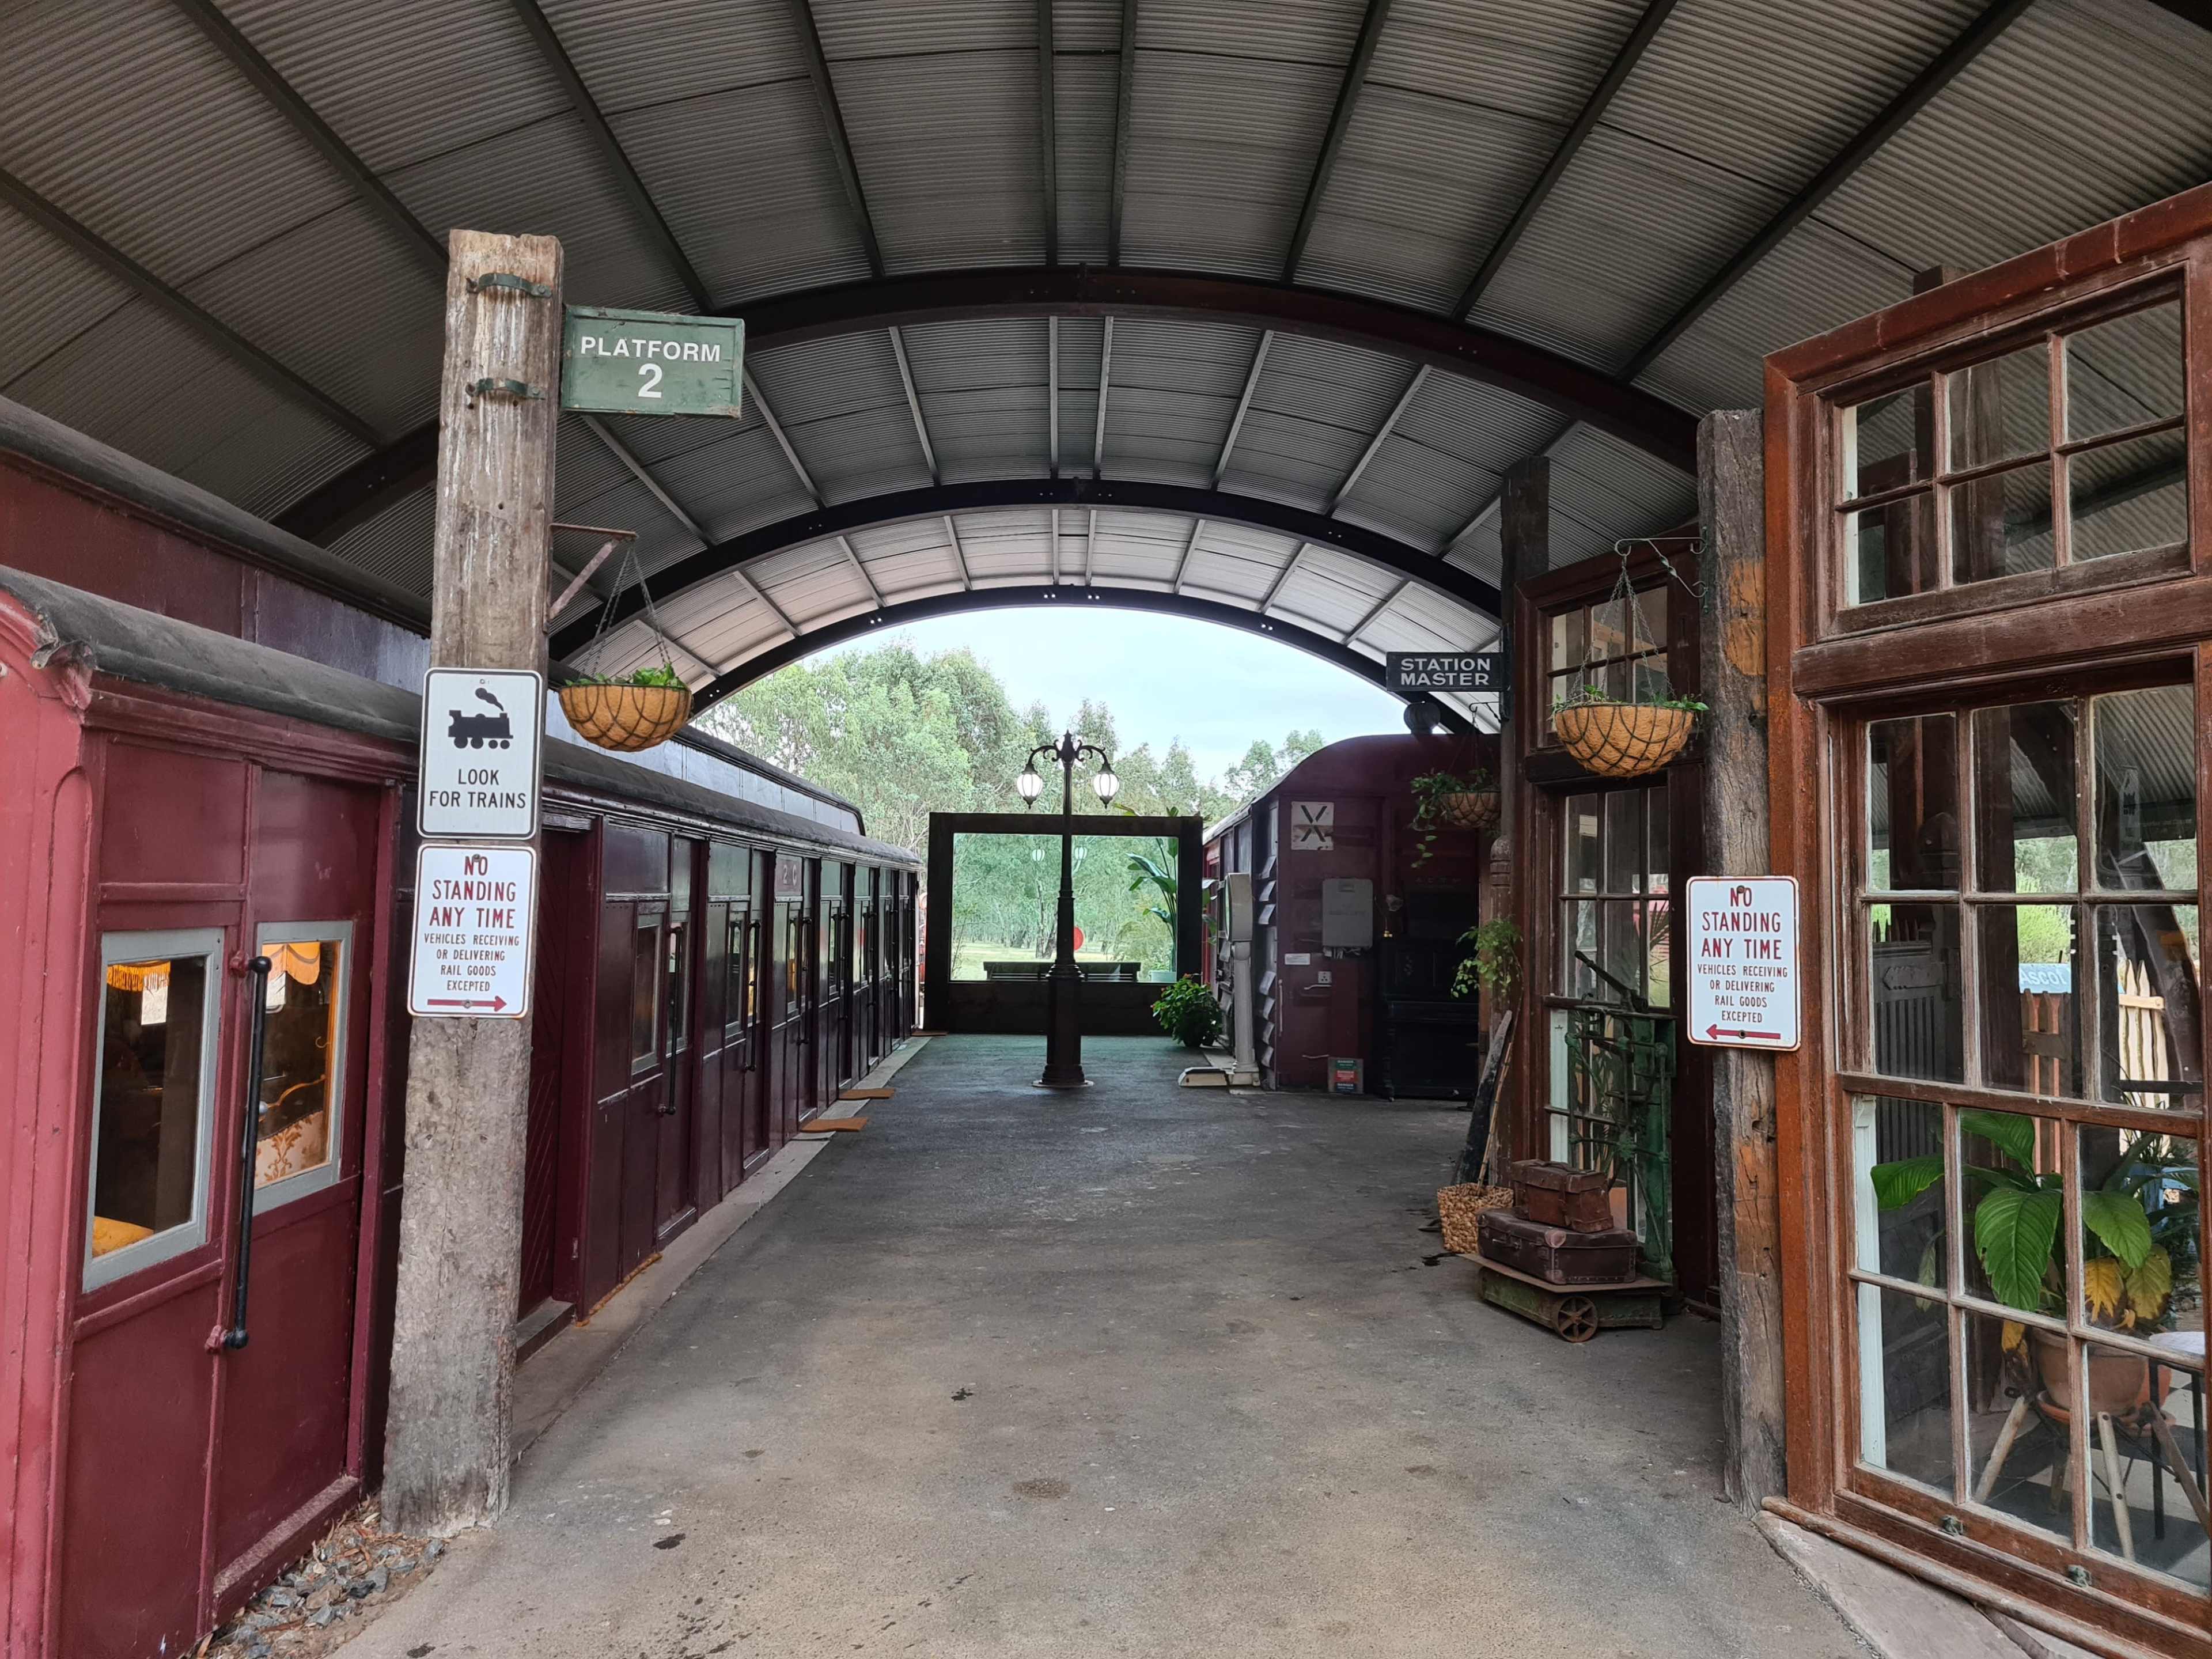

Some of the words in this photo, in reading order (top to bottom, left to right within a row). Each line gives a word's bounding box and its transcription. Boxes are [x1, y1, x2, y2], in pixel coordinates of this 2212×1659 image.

[581, 336, 721, 362] PLATFORM
[638, 363, 662, 399] 2
[1400, 658, 1490, 671] STATION
[1400, 673, 1489, 685] MASTER
[458, 768, 499, 786] LOOK
[430, 790, 461, 807] FOR
[468, 791, 526, 809] TRAINS
[464, 855, 488, 876] NO
[432, 879, 516, 902] STANDING
[1730, 887, 1752, 907] NO
[429, 906, 465, 927] ANY
[476, 907, 516, 929] TIME
[1702, 911, 1781, 933] STANDING
[424, 933, 466, 945] VEHICLES
[473, 934, 520, 946] RECEIVING
[437, 949, 448, 960] OR
[453, 949, 506, 961] DELIVERING
[1701, 938, 1733, 959] ANY
[1744, 939, 1782, 960] TIME
[440, 964, 462, 976] RAIL
[467, 965, 497, 976] GOODS
[1697, 964, 1737, 976] VEHICLES
[1743, 965, 1788, 978] RECEIVING
[446, 980, 490, 992] EXCEPTED
[1710, 980, 1721, 990] OR
[1725, 981, 1775, 993] DELIVERING
[1714, 995, 1734, 1006] RAIL
[1739, 997, 1767, 1008] GOODS
[1721, 1010, 1763, 1023] EXCEPTED
